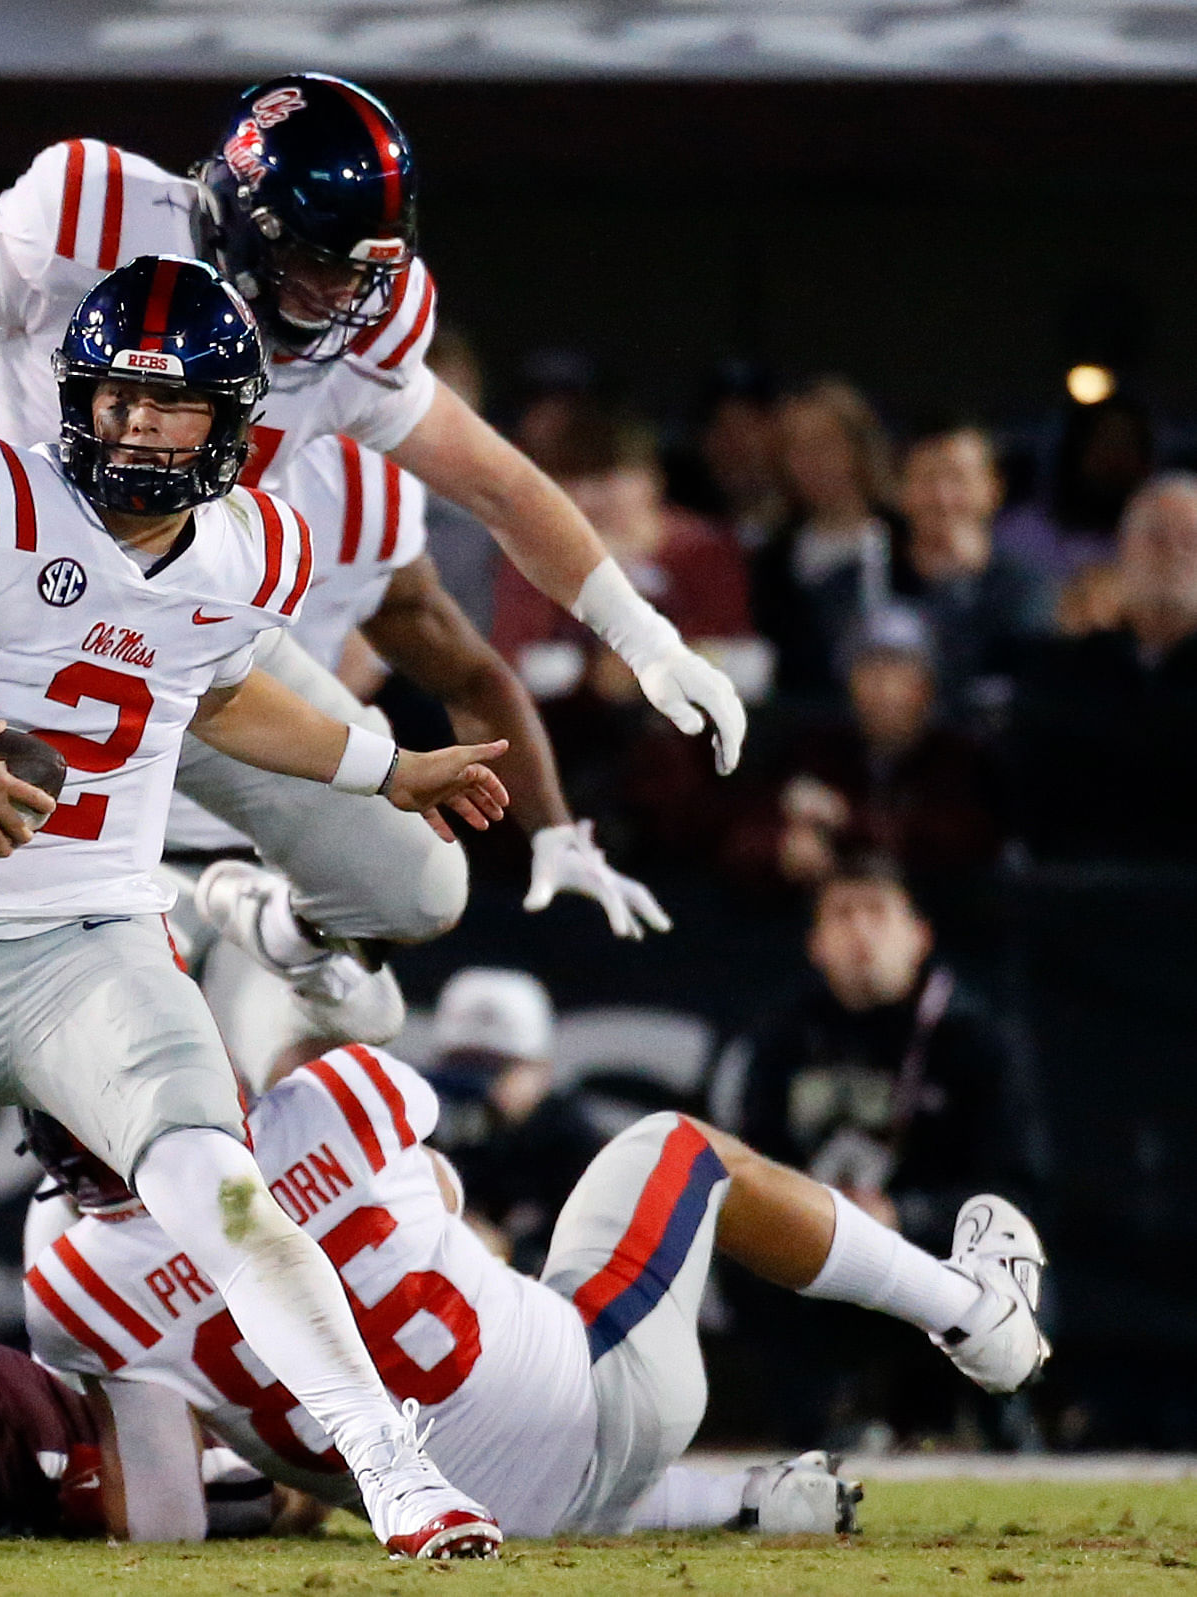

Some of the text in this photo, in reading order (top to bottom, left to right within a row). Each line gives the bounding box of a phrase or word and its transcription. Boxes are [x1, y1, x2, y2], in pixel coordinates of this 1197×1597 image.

[127, 353, 169, 371] REBS
[41, 560, 84, 600] SEC
[81, 621, 155, 669] Ole Miss
[28, 660, 155, 841] 2
[191, 1205, 483, 1475] 86
